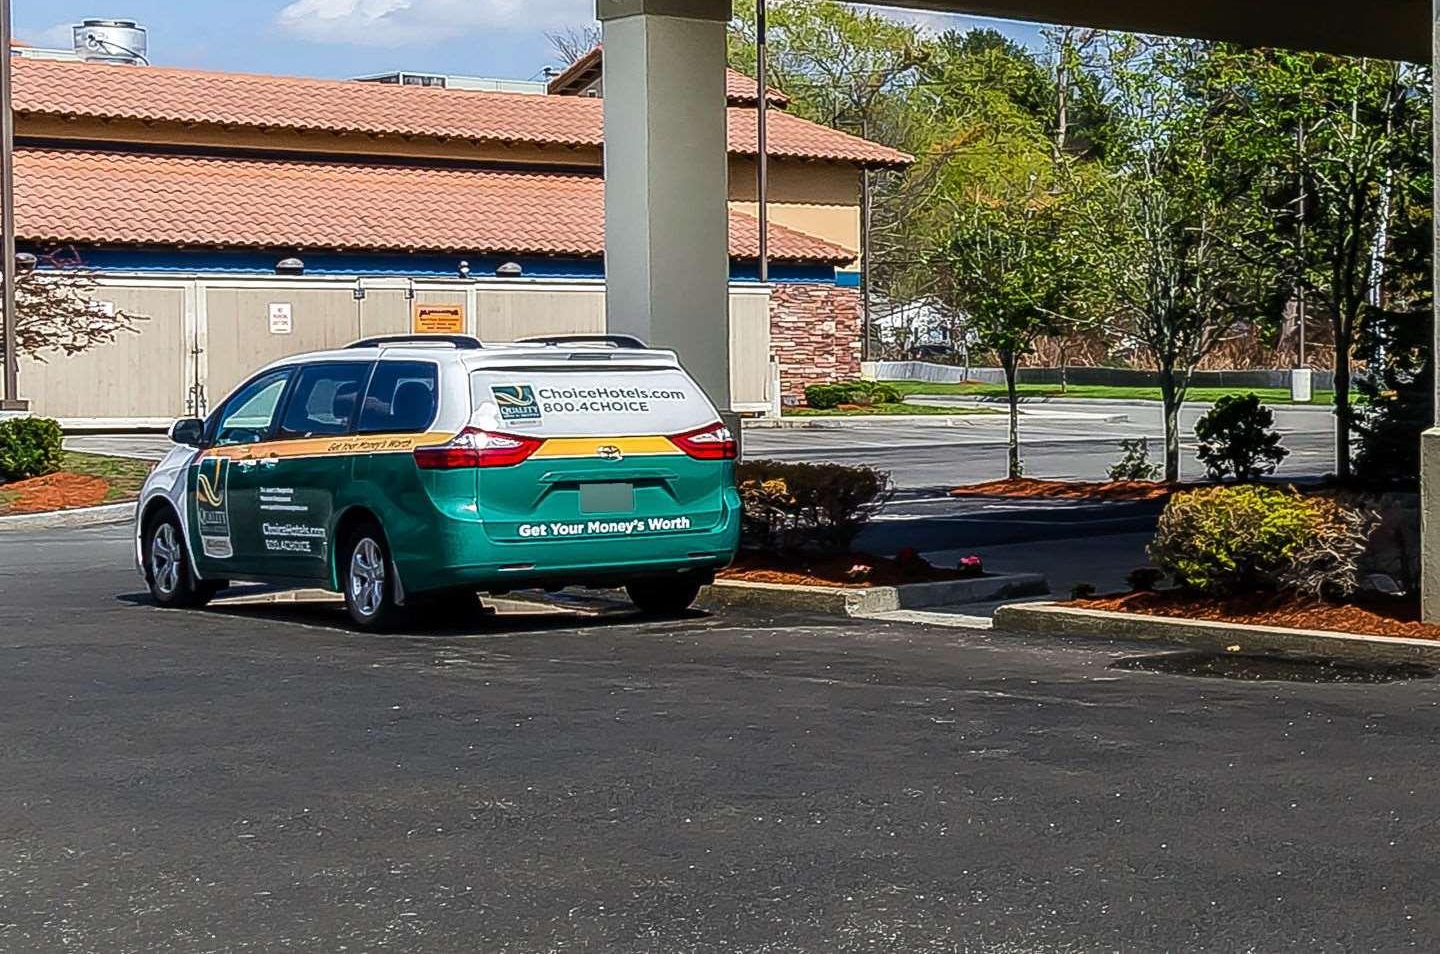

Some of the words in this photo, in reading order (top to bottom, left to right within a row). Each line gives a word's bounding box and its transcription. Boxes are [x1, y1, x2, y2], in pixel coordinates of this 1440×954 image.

[539, 388, 685, 400] ChoiceHotels.com
[501, 406, 538, 415] QUALITY
[543, 402, 649, 413] 800.4CHOICE
[519, 524, 546, 537] Get
[550, 522, 584, 535] Your
[587, 519, 645, 534] Money's
[648, 516, 691, 531] Worth
